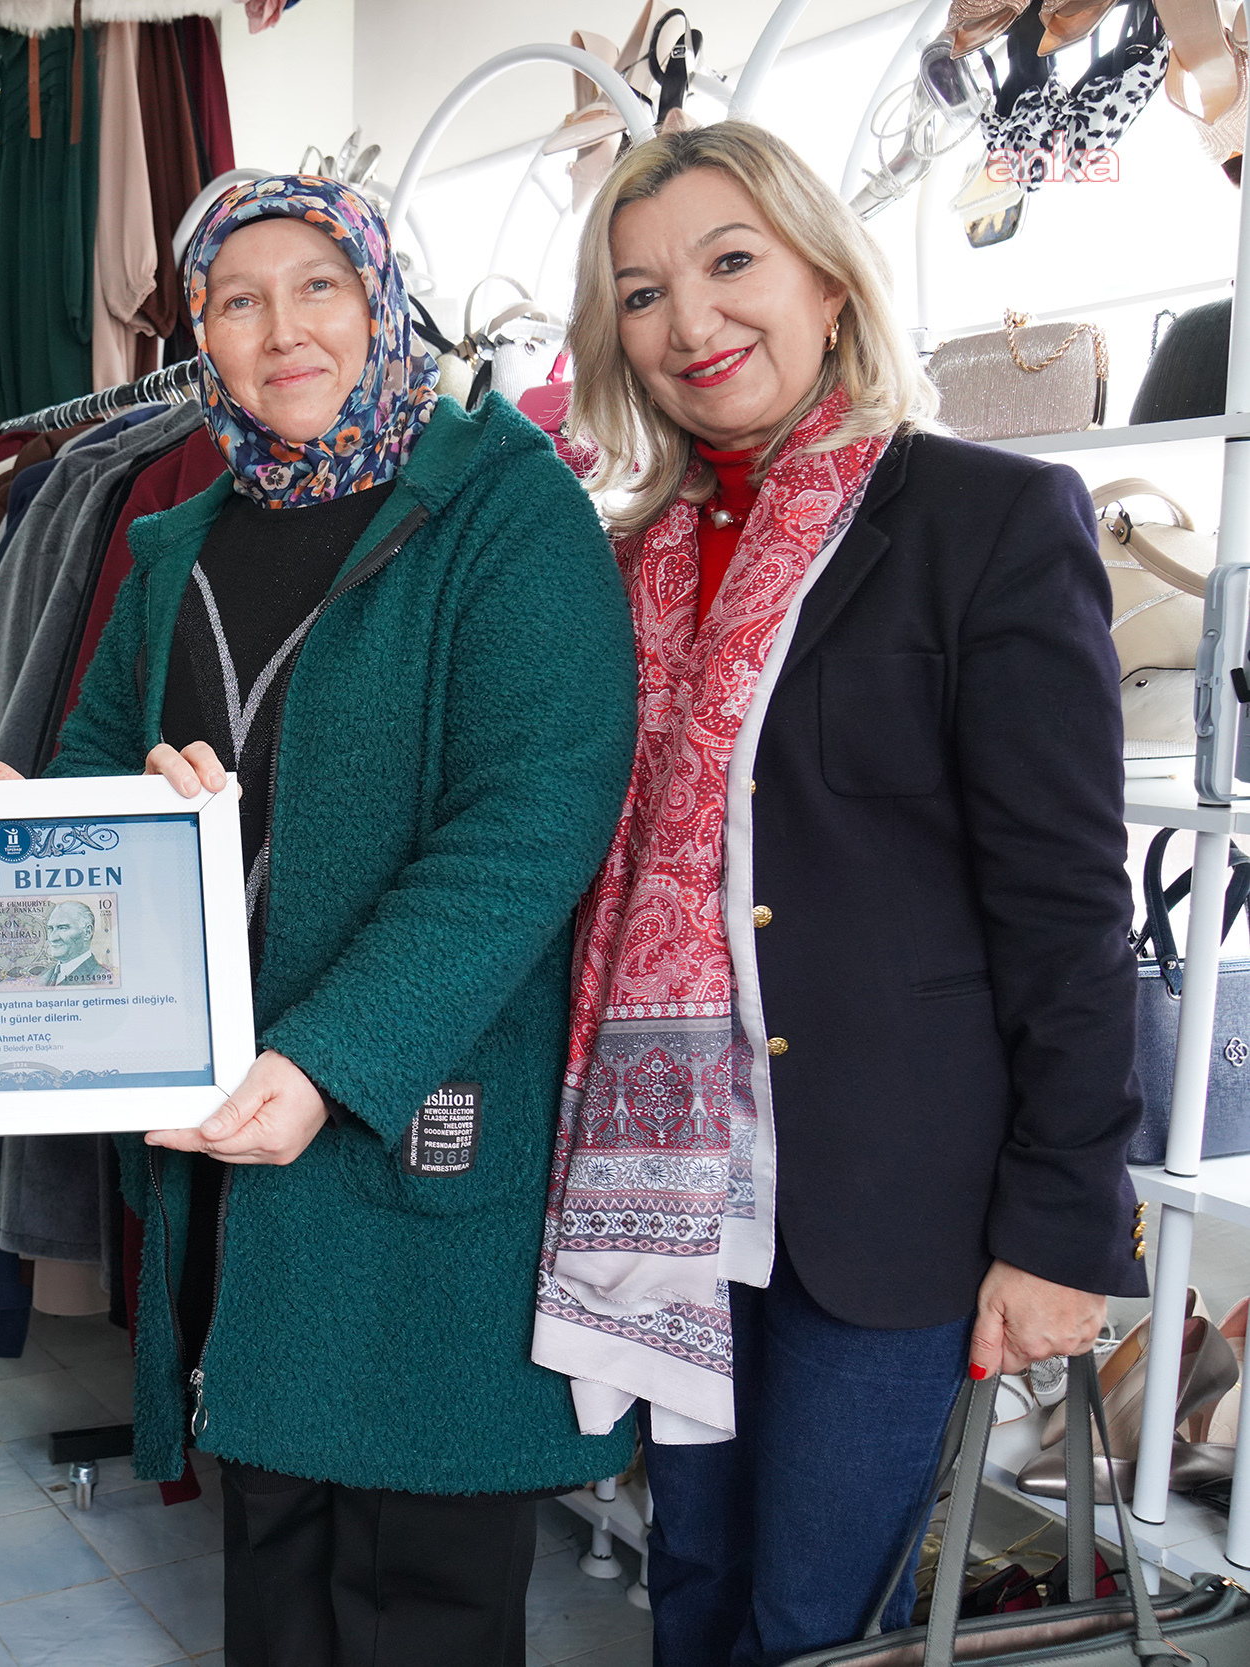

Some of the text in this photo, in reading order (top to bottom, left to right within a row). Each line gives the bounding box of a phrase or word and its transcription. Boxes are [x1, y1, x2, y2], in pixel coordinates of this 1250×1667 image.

[14, 864, 122, 889] BİZDEN
[99, 899, 112, 909] 10
[4, 920, 19, 928] ON
[36, 999, 80, 1009] başarılar
[82, 996, 129, 1008] getirmesi
[132, 994, 178, 1006] dileğiyle,
[9, 1014, 41, 1025] günler
[44, 1013, 82, 1023] dilerim.
[27, 1033, 52, 1042] ATAÇ
[3, 1044, 34, 1052] Belediye
[35, 1043, 64, 1051] Başkanı
[423, 1149, 469, 1164] 1968
[421, 1163, 470, 1172] NEWBESTWEAR
